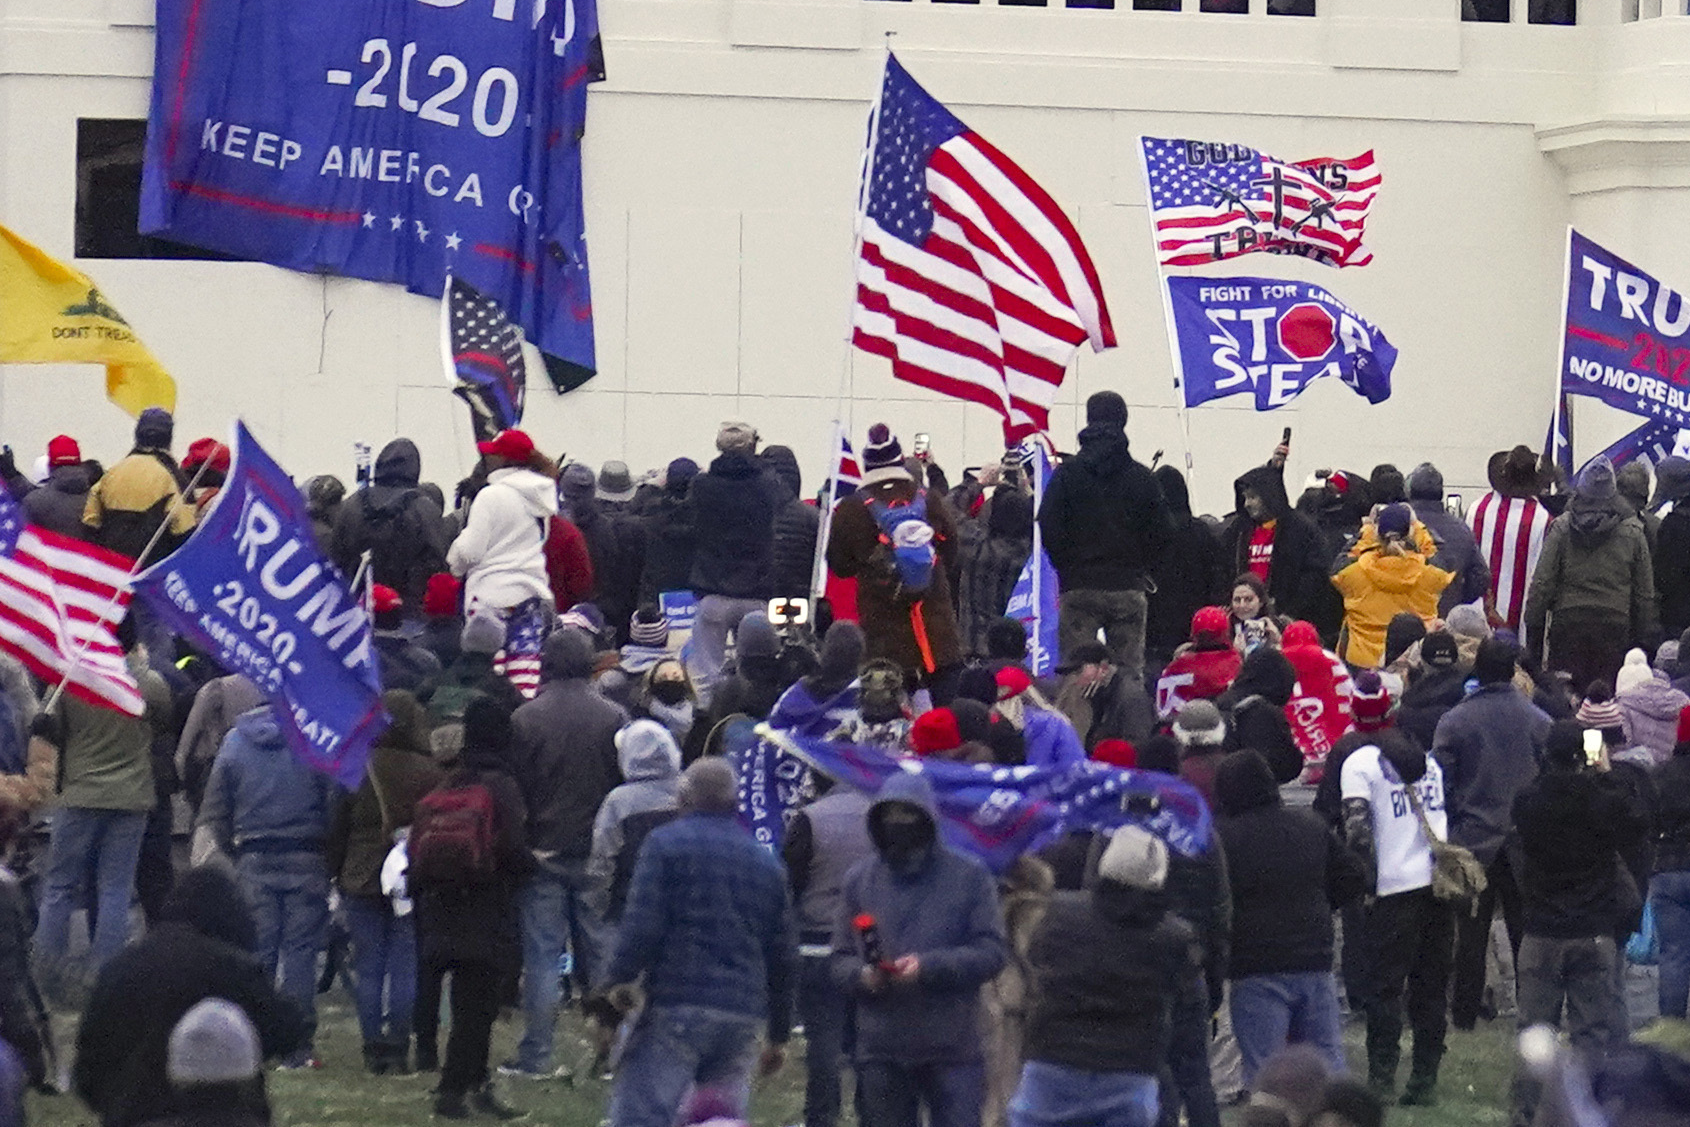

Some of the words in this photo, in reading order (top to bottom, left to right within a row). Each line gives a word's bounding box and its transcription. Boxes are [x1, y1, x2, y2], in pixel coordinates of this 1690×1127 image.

[201, 117, 302, 171] KEEP
[1184, 139, 1253, 166] GOD
[1200, 286, 1252, 303] FIGHT
[1261, 284, 1298, 300] FOR
[1569, 355, 1603, 383] NO
[1602, 369, 1668, 402] MORE
